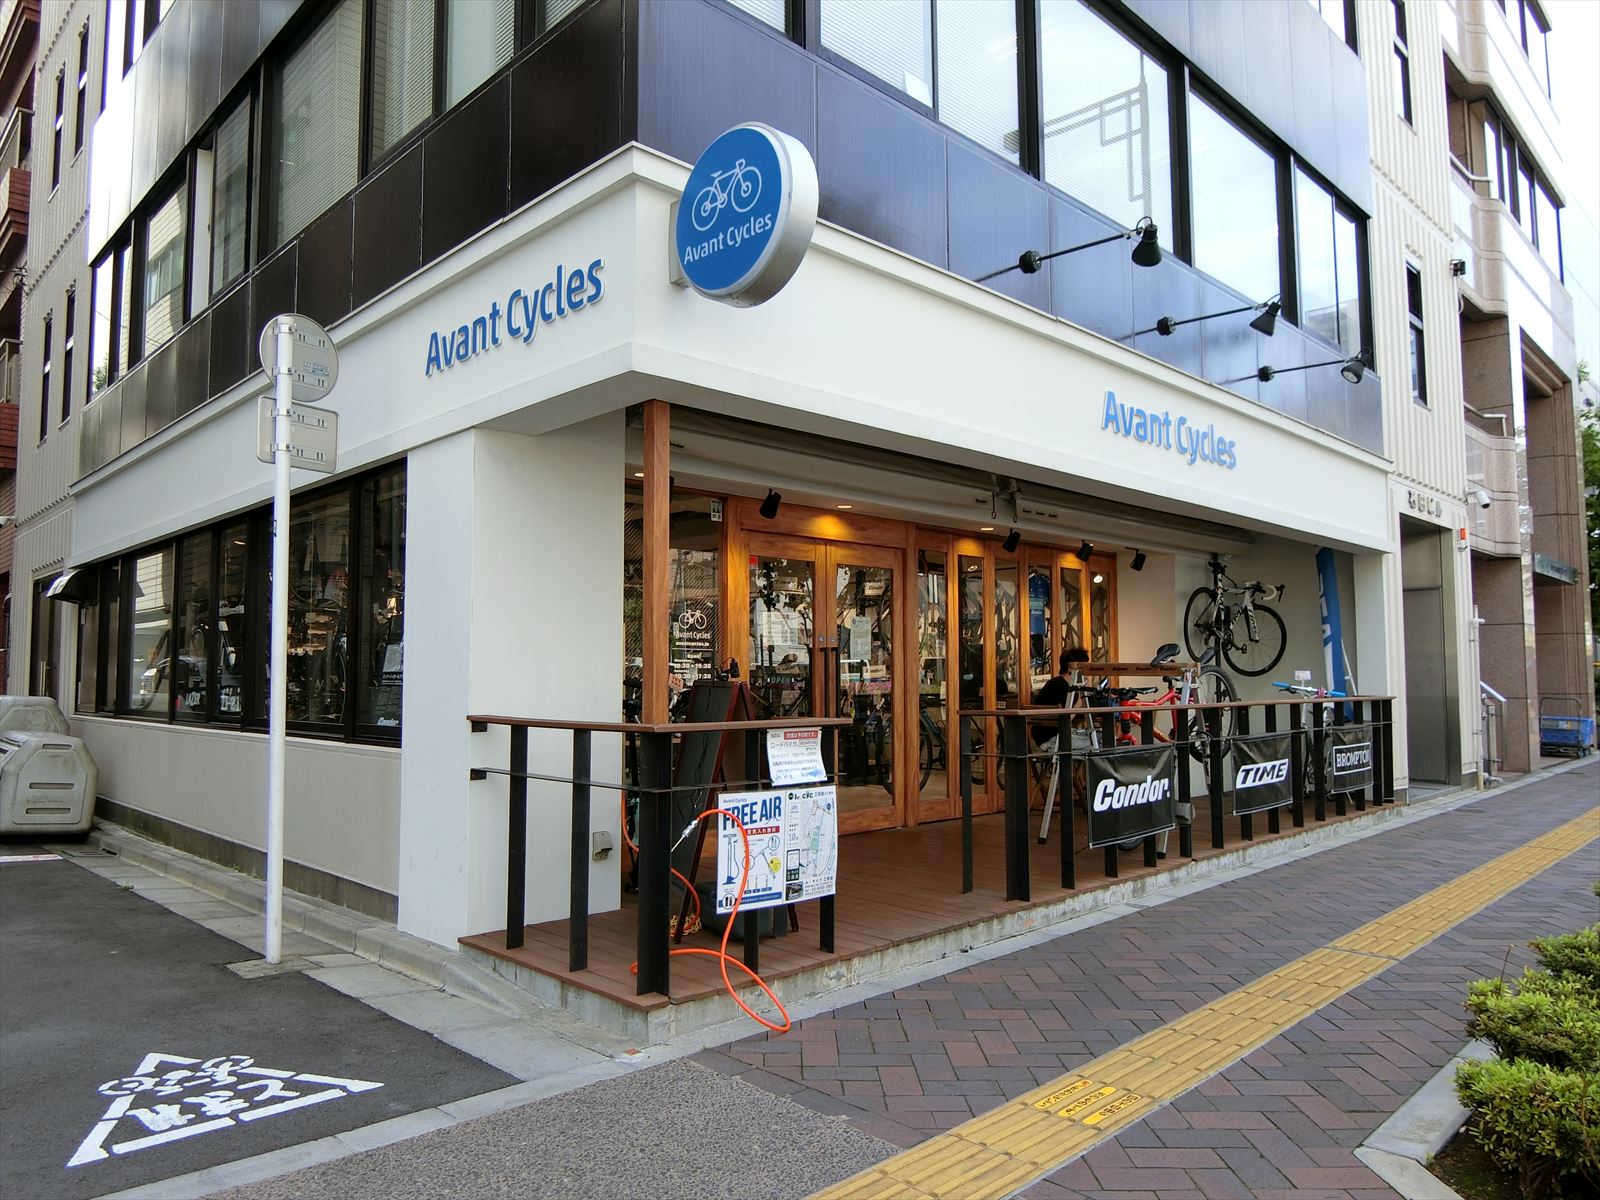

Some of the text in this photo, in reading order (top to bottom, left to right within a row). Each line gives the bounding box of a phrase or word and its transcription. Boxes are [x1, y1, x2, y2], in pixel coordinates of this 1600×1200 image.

[684, 213, 773, 265] Avant Cycles
[425, 258, 605, 377] Avant Cycles
[1101, 390, 1237, 470] Avant Cycles
[1240, 762, 1287, 785] TIME
[723, 795, 782, 831] FREE AIR
